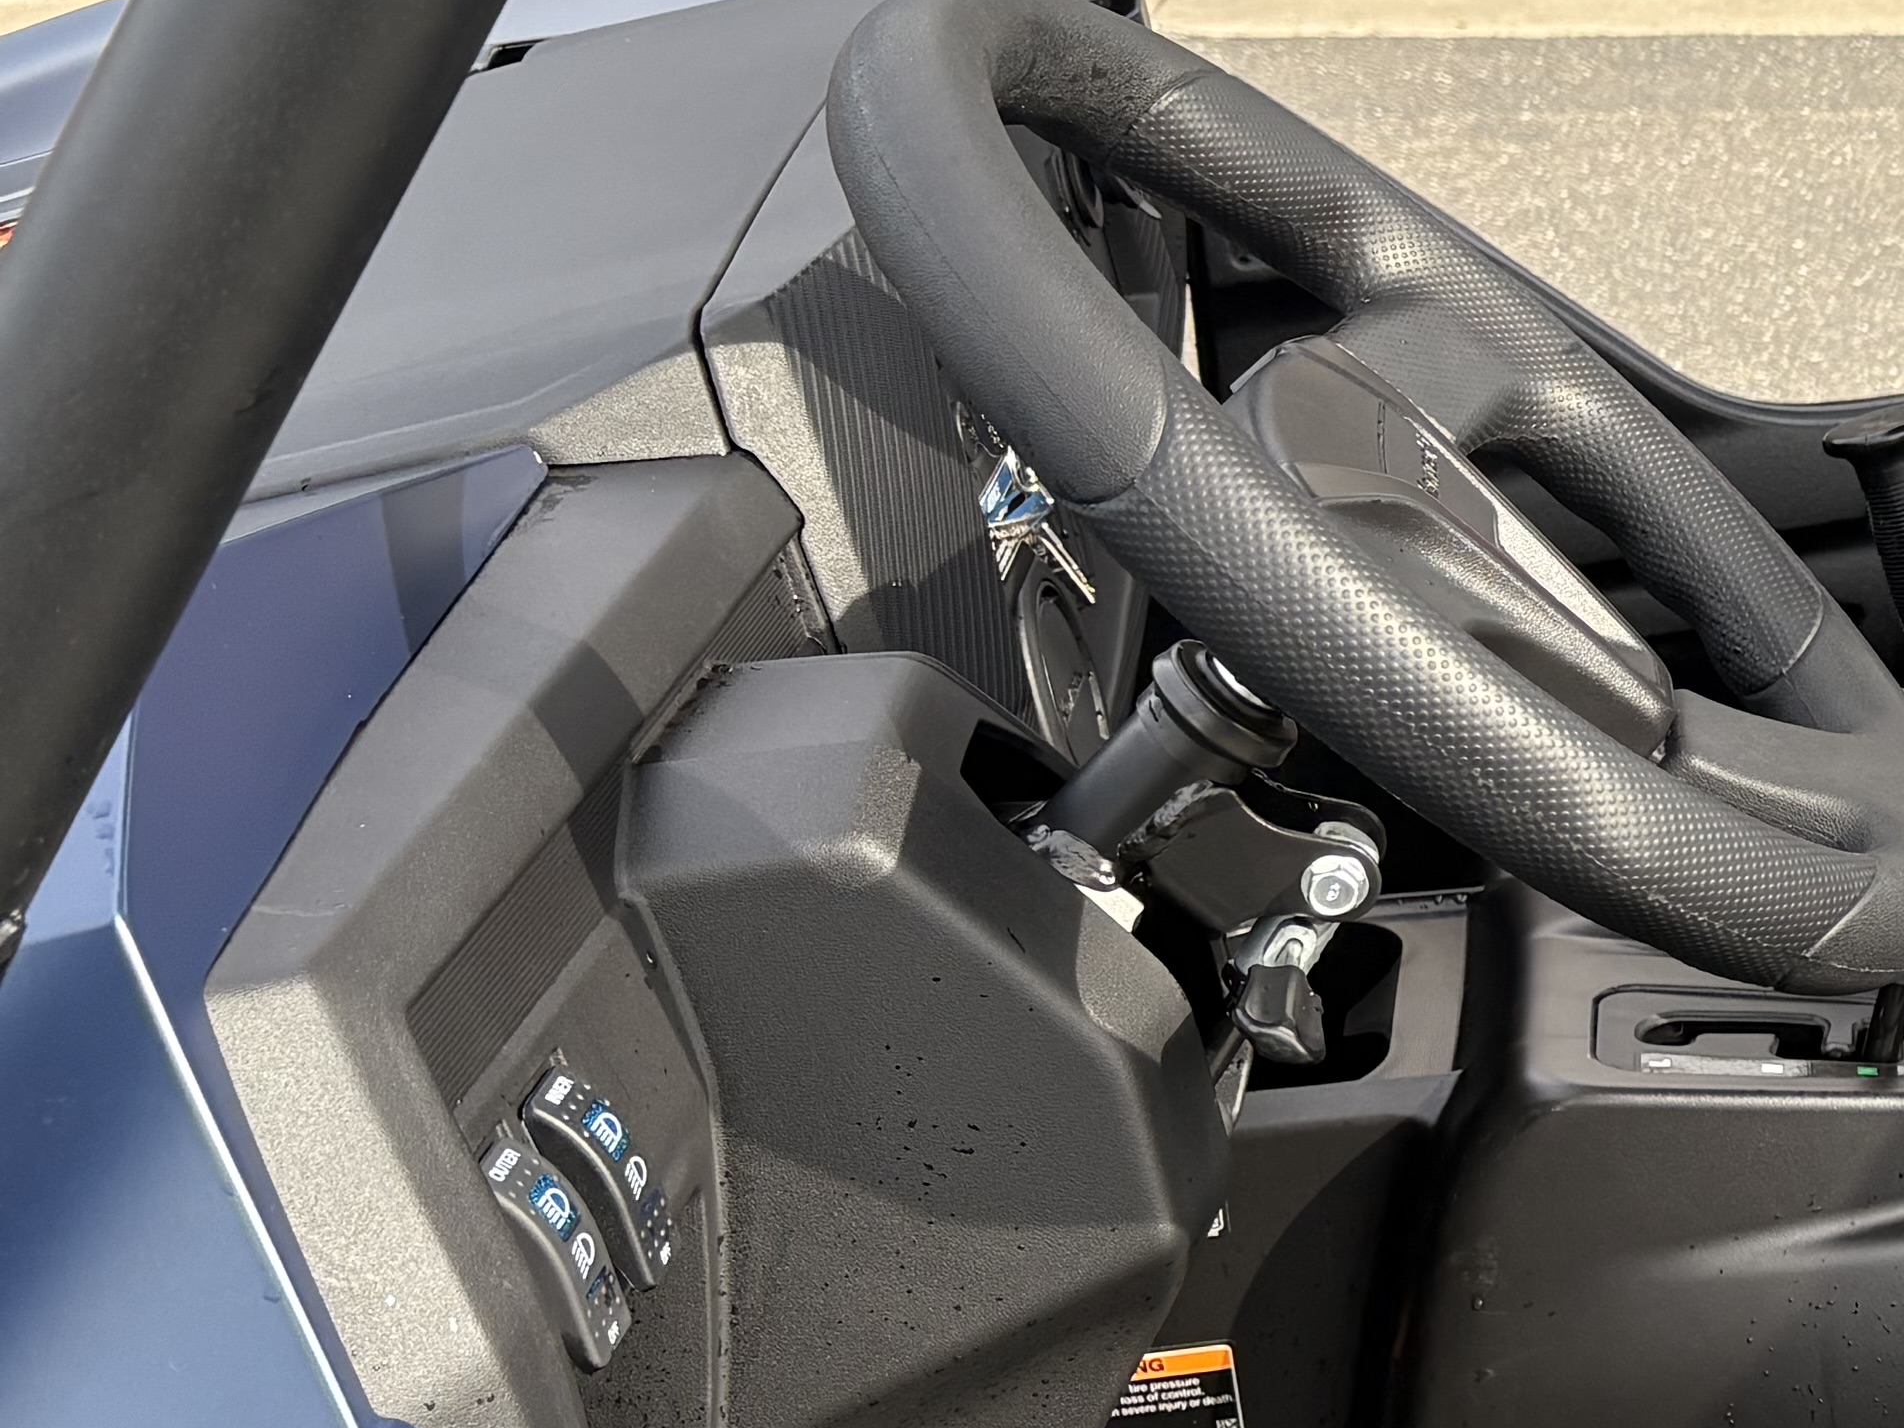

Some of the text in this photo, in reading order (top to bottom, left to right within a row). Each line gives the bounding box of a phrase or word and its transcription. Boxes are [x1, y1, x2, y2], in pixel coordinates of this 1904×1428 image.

[544, 1075, 575, 1106] INNER
[488, 1148, 522, 1183] OUTER
[1149, 1377, 1201, 1392] pressure
[1119, 1386, 1206, 1406] loss of control.
[1120, 1404, 1158, 1417] severe
[1158, 1400, 1188, 1413] injury
[1188, 1398, 1201, 1409] or
